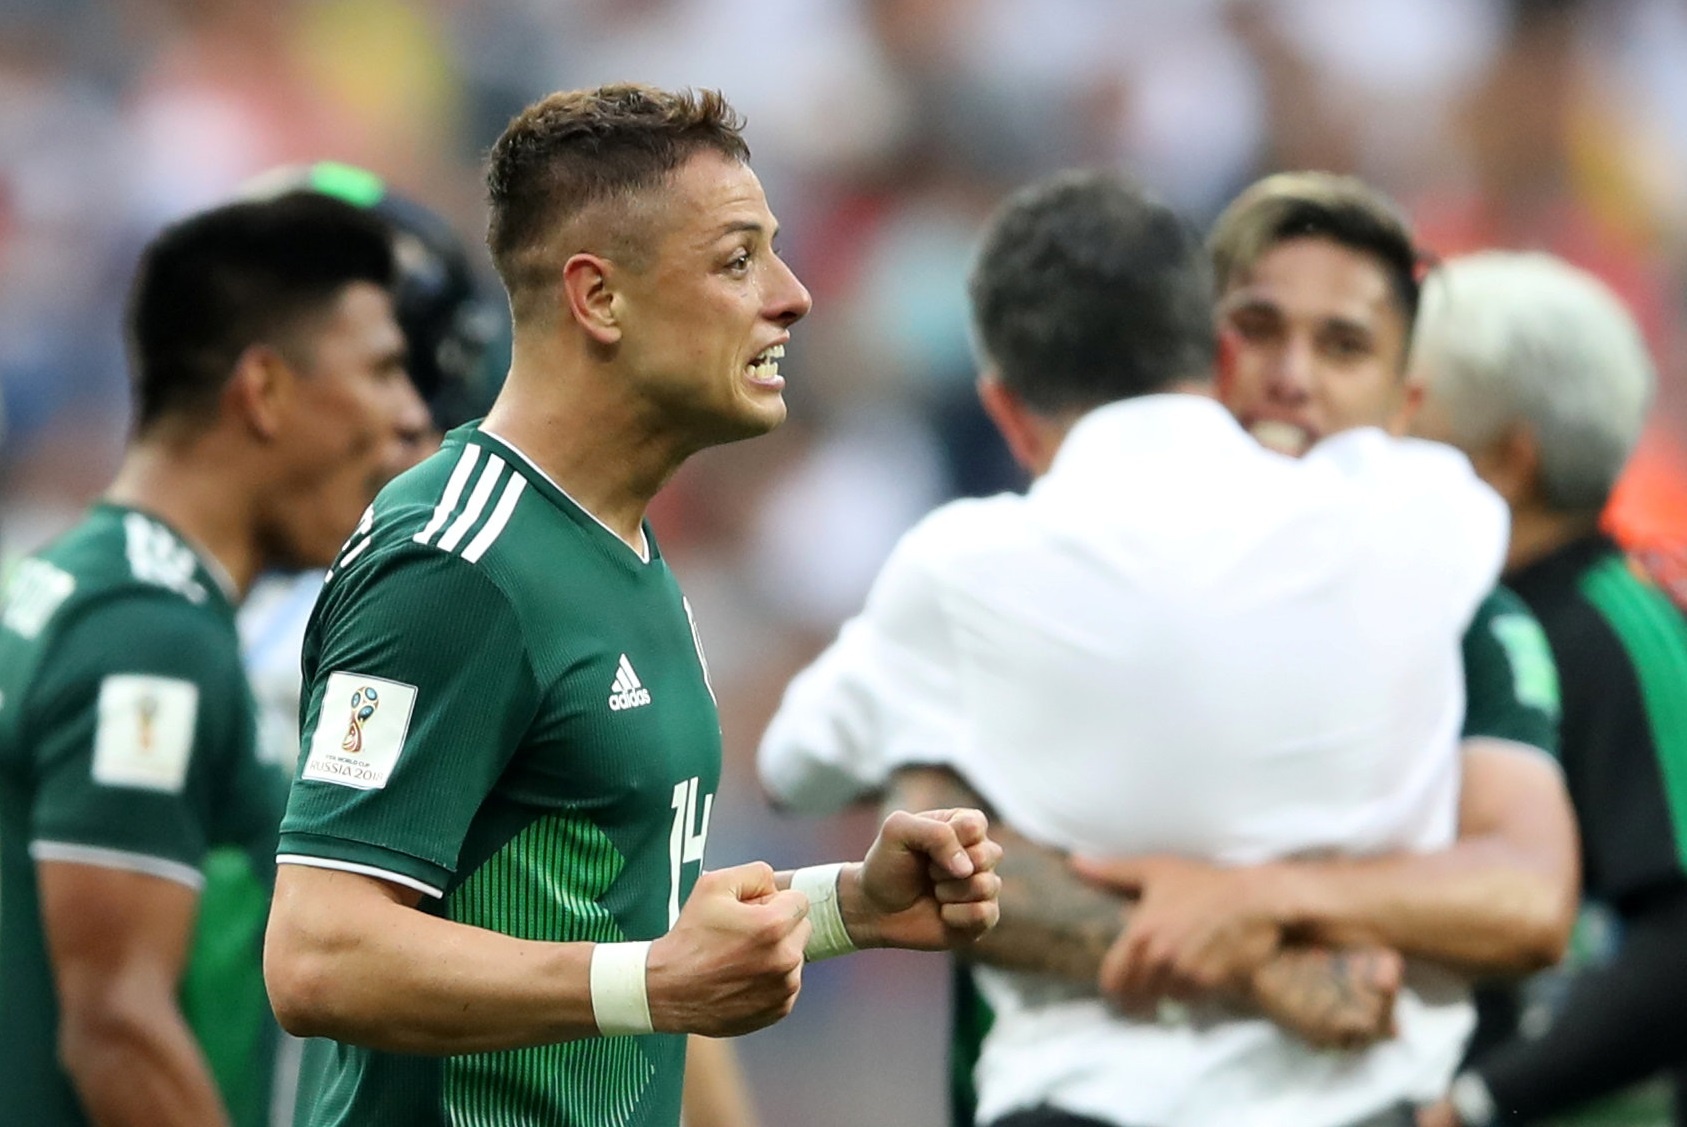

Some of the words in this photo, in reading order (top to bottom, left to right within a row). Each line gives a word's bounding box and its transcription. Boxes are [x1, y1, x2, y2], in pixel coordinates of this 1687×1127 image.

[608, 688, 651, 711] adidas
[309, 760, 352, 777] RUSSIA
[337, 756, 358, 766] WORLD
[359, 760, 371, 768] CUP
[668, 776, 714, 932] 14
